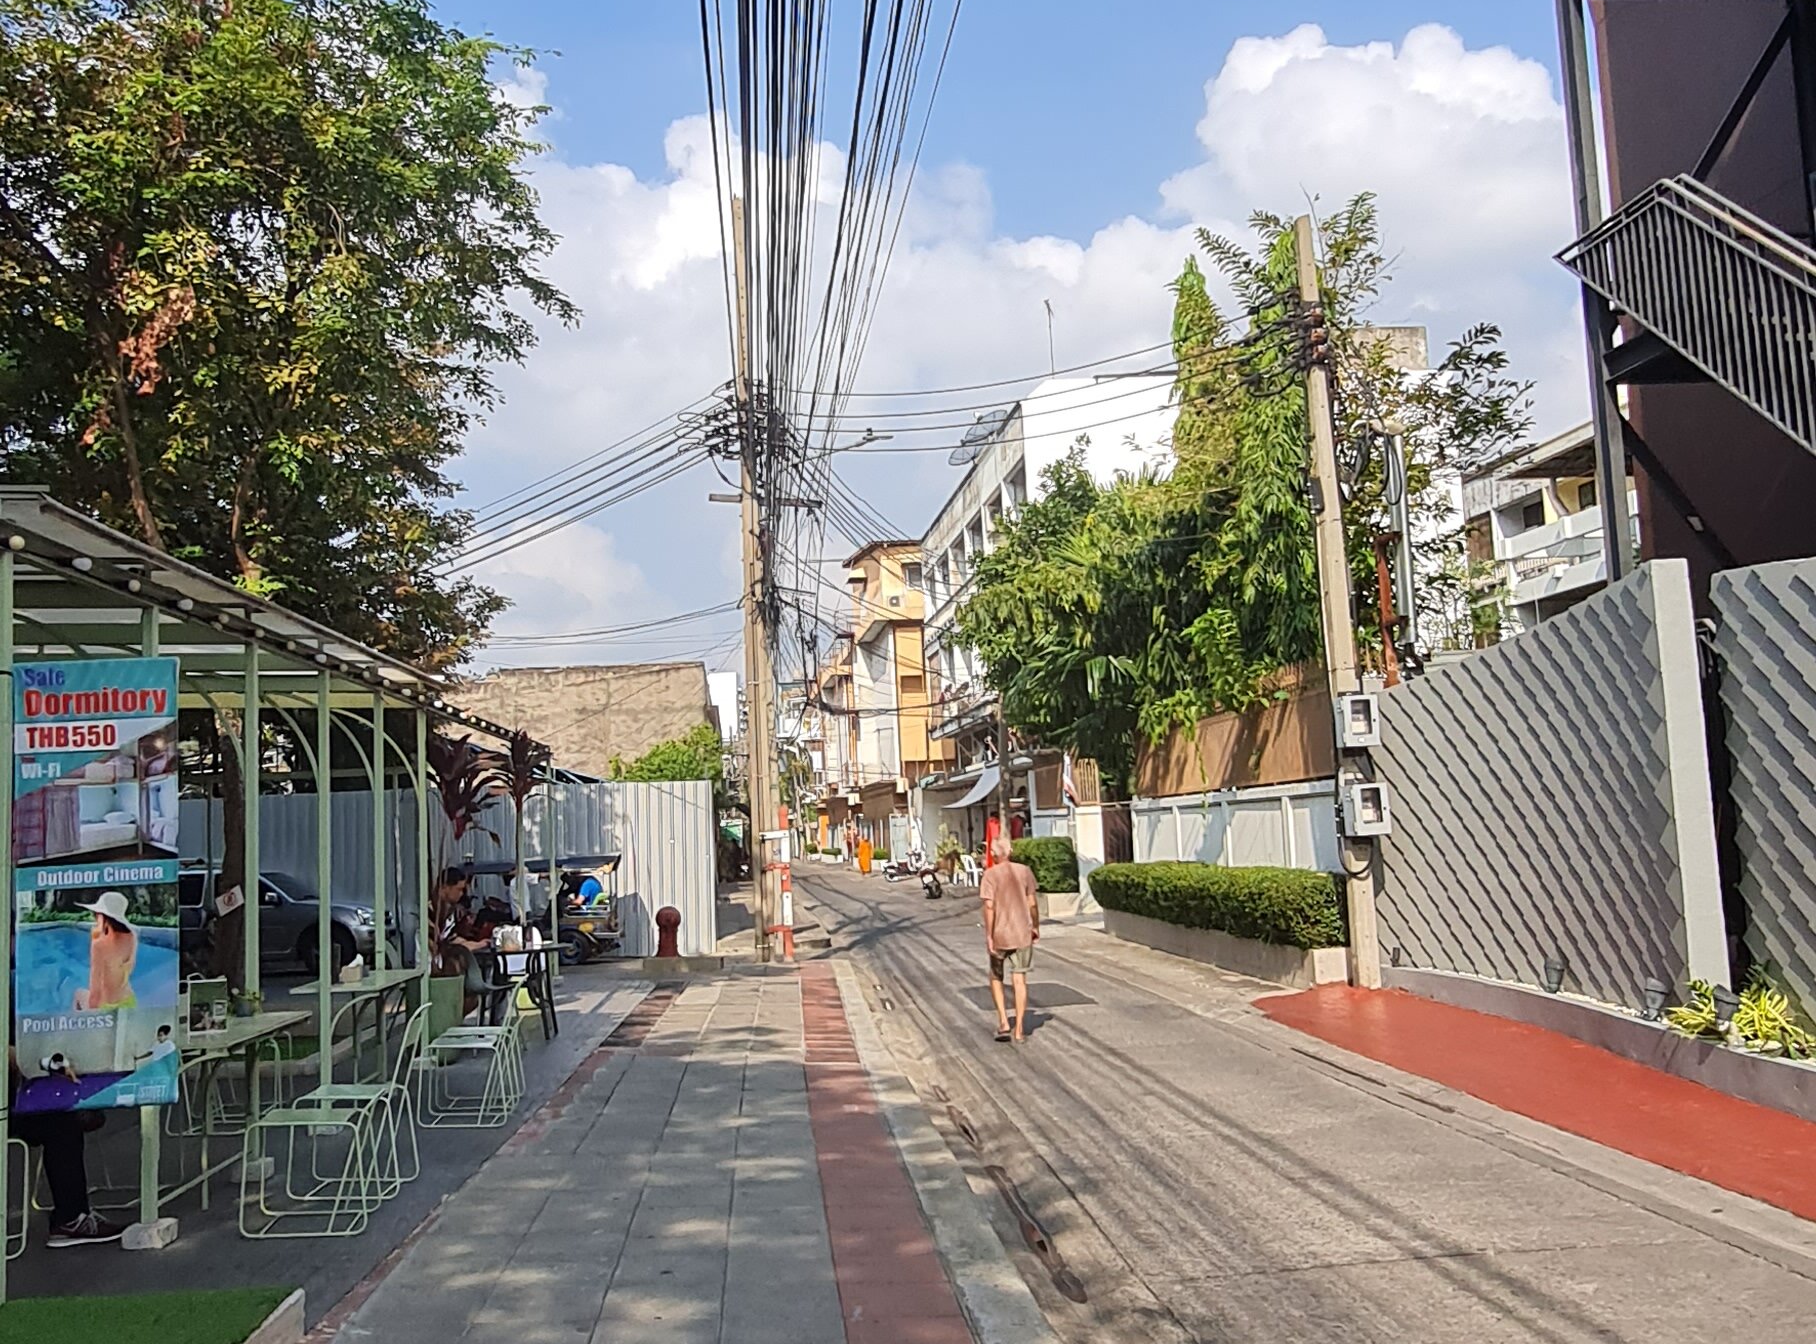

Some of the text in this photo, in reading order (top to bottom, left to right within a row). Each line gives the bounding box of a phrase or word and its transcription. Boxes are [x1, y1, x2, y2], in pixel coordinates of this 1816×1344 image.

[24, 687, 167, 717] Dormitory
[38, 865, 164, 886] Outdoor Cinema
[23, 1014, 114, 1033] Pool Access
